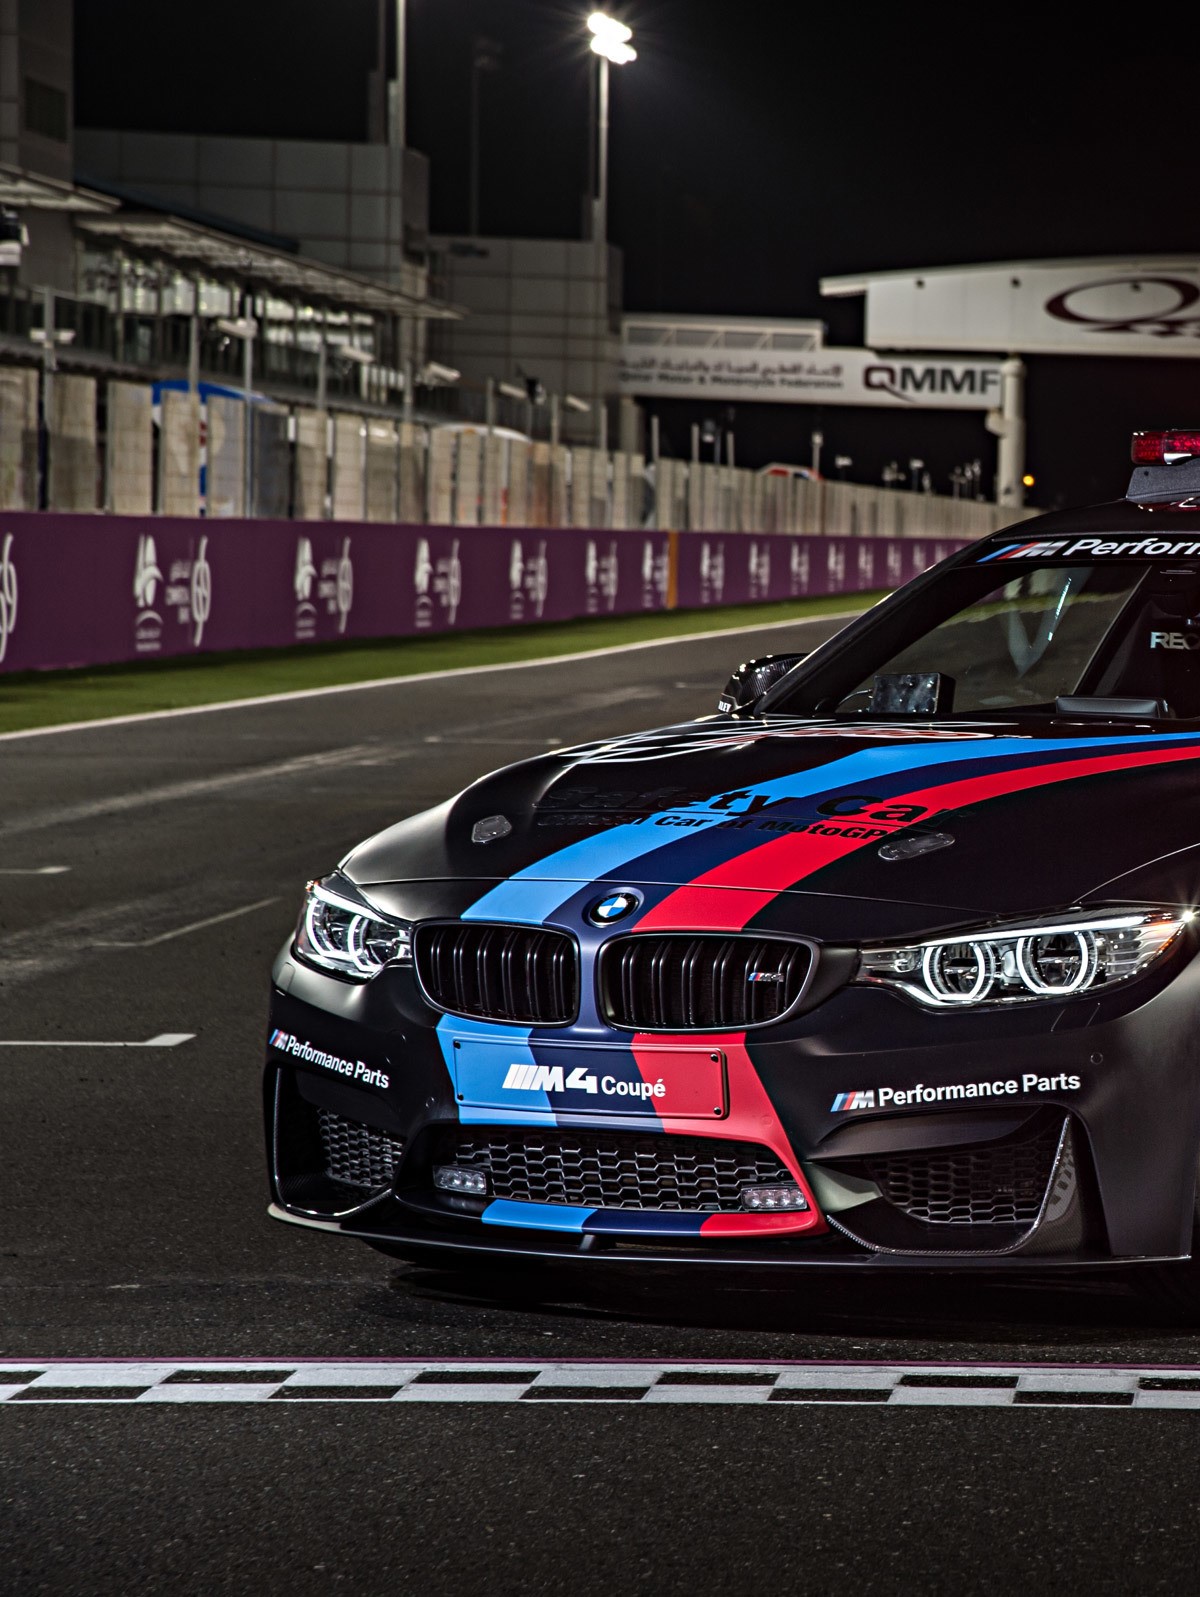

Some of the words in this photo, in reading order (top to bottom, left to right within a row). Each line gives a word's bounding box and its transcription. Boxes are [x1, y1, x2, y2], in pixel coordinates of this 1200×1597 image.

[863, 365, 1000, 402] QMMF
[654, 815, 713, 828] Car
[285, 1034, 354, 1076] Performance
[354, 1060, 390, 1089] Parts
[601, 1076, 667, 1101] Coupé
[877, 1077, 1019, 1107] Performance
[1022, 1072, 1081, 1093] Parts
